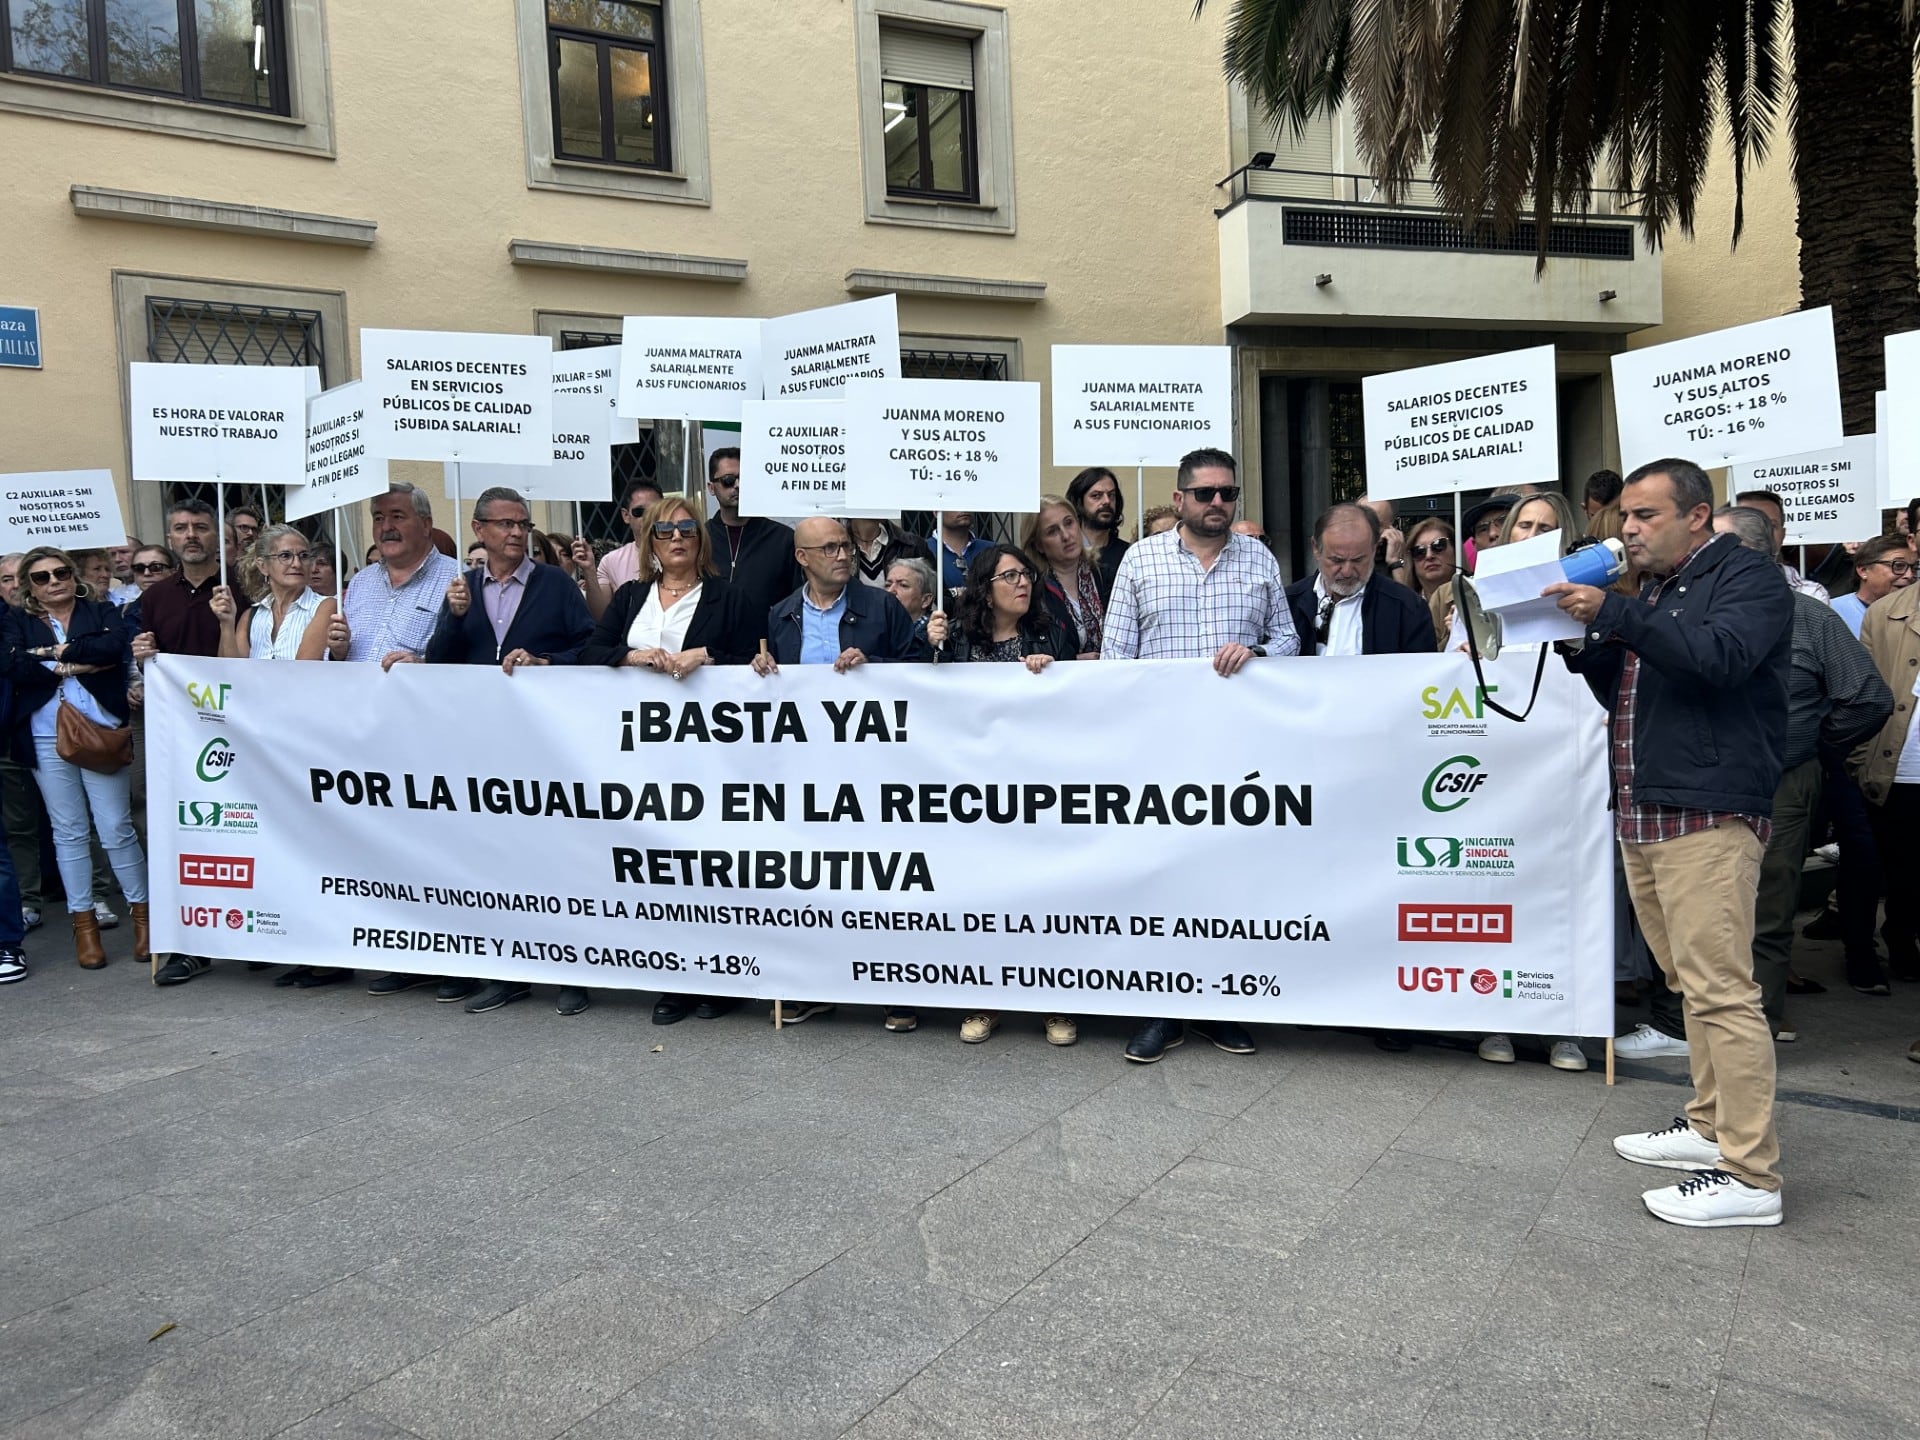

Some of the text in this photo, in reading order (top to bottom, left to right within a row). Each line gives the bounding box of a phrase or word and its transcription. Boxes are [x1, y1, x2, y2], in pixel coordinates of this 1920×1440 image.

[645, 348, 742, 359] JUANMA MALTRATA
[784, 335, 876, 360] JUANMA MALTRATA
[387, 359, 526, 375] SALARIOS DECENTES
[650, 364, 734, 374] SALARIALMENTE
[791, 353, 870, 376] SALARIALMENTE
[1653, 348, 1790, 388] JUANMA MORENO
[595, 369, 611, 379] SMI
[411, 380, 503, 394] EN SERVICIOS
[636, 379, 746, 390] A SUS FUNCIONARIOS
[780, 382, 807, 395] A SUS
[1082, 383, 1202, 393] JUANMA MALTRATA
[1674, 374, 1770, 403] Y SUS ALTOS
[1388, 380, 1527, 412] SALARIOS DECENTES
[384, 395, 532, 414] PÚBLICOS DE CALIDAD
[1090, 401, 1194, 412] SALARIALMENTE
[1664, 396, 1767, 425] CARGOS: 18
[153, 408, 284, 422] ES HORA DE VALORAR
[883, 409, 1004, 422] JUANMA MORENO
[1411, 404, 1503, 428] EN SERVICIOS
[312, 416, 346, 436] AUXILIAR
[395, 418, 520, 434] ¡SUBIDA SALARIAL!
[1074, 419, 1210, 430] A SUS FUNCIONARIOS
[1688, 421, 1745, 441] TÚ: 16
[160, 426, 278, 439] NUESTRO TRABAJO
[769, 427, 838, 437] C2 AUXILIAR
[902, 429, 986, 442] Y SUS ALTOS
[1385, 420, 1533, 450] PÚBLICOS DE CALIDAD
[310, 428, 359, 454] NOSOTROS SI
[781, 445, 845, 455] NOSOTROS
[890, 448, 981, 462] CARGOS: 18
[1396, 441, 1522, 471] ¡SUBIDA SALARIAL!
[318, 457, 328, 469] NO
[765, 463, 808, 474] QUE NO
[1754, 462, 1850, 478] C2 AUXILIAR SMI
[312, 464, 358, 488] A FIN DE MES
[910, 466, 961, 481] TÚ: 16
[782, 480, 828, 490] A FIN DE
[1829, 478, 1838, 488] SI
[21, 490, 66, 499] AUXILIAR
[1795, 492, 1854, 506] LLEGAMOS
[20, 502, 74, 510] NOSOTROS
[9, 516, 30, 525] QUE
[49, 511, 100, 521] LLEGAMOS
[1798, 510, 1837, 521] DE MES
[1422, 685, 1498, 720] SAF
[621, 700, 908, 751] ¡BASTA YA!
[206, 750, 236, 767] CSIF
[1436, 773, 1488, 793] CSIF
[310, 768, 1312, 826] POR LA IGUALDAD EN LA RECUPERACIÓN
[224, 811, 254, 820] SINDICAL
[1465, 838, 1514, 846] INICIATIVA
[1466, 849, 1508, 858] SINDICAL
[612, 847, 934, 891] RETRIBUTIVA
[1466, 860, 1514, 869] ANDALUZA
[184, 862, 248, 882] CCOO
[322, 877, 1330, 941] PERSONAL FUNCIONARIO DE LA ADMINISTRACIÓN GENERAL DE LA JUNTA DE ANDALUCÍA
[181, 906, 222, 928] UGT
[1406, 912, 1504, 933] CCOO
[353, 928, 760, 976] PRESIDENTE Y ALTOS CARGOS: +18%
[852, 962, 1280, 996] PERSONAL FUNCIONARIO: -16%
[1398, 966, 1464, 992] UGT
[1518, 971, 1554, 980] Servicios
[1518, 982, 1550, 990] Públicos
[1518, 991, 1564, 1000] Andalucía
